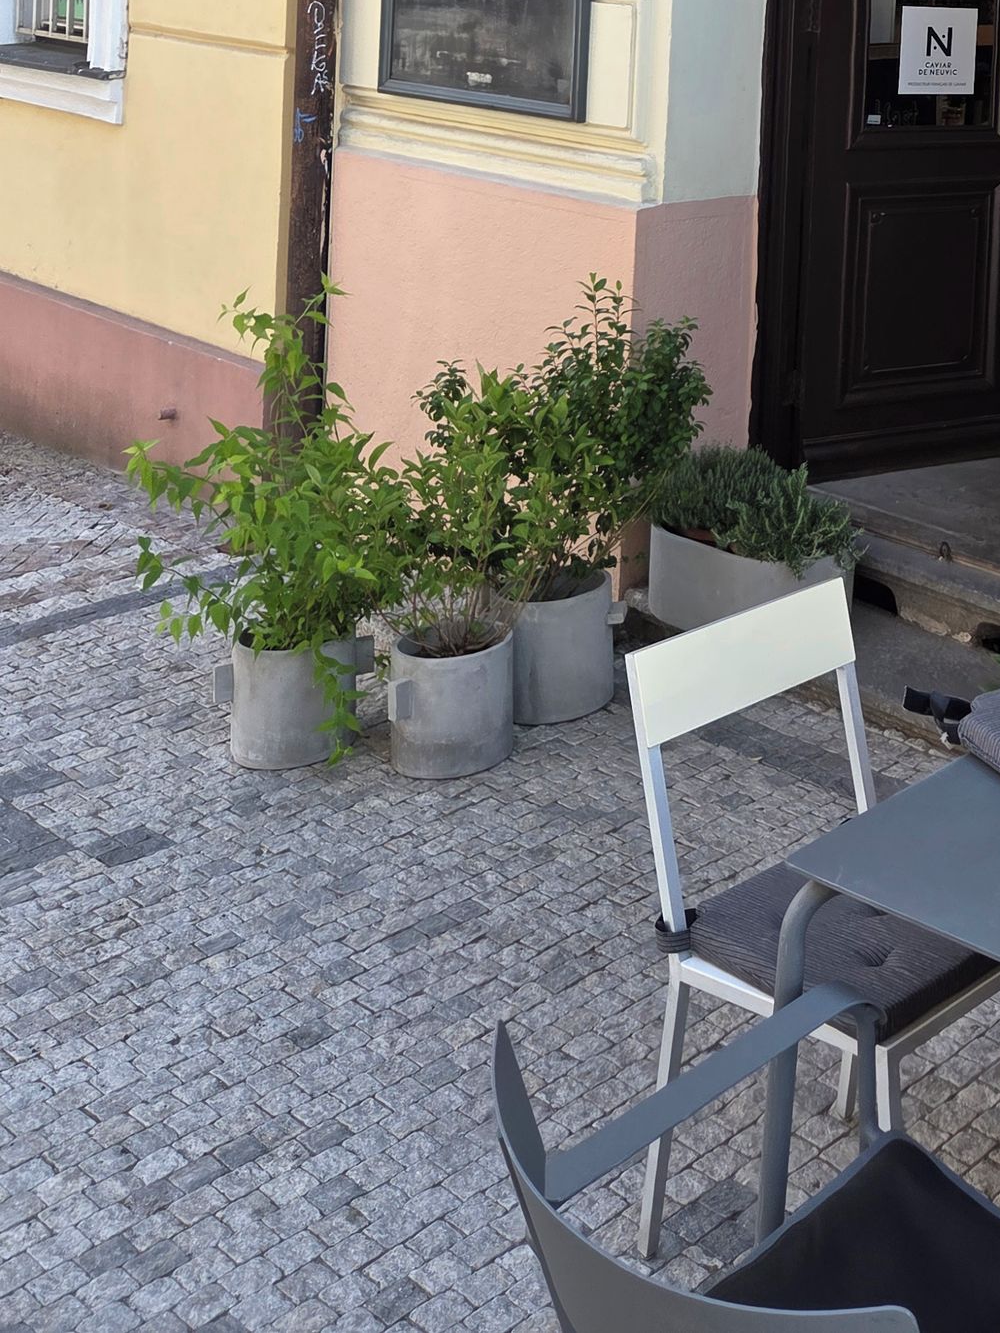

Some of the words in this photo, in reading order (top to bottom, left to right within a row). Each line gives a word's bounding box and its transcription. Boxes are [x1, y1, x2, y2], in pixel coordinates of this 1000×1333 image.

[924, 61, 952, 69] CAVIAR
[918, 68, 928, 76] DE
[929, 68, 958, 76] NEUVIC
